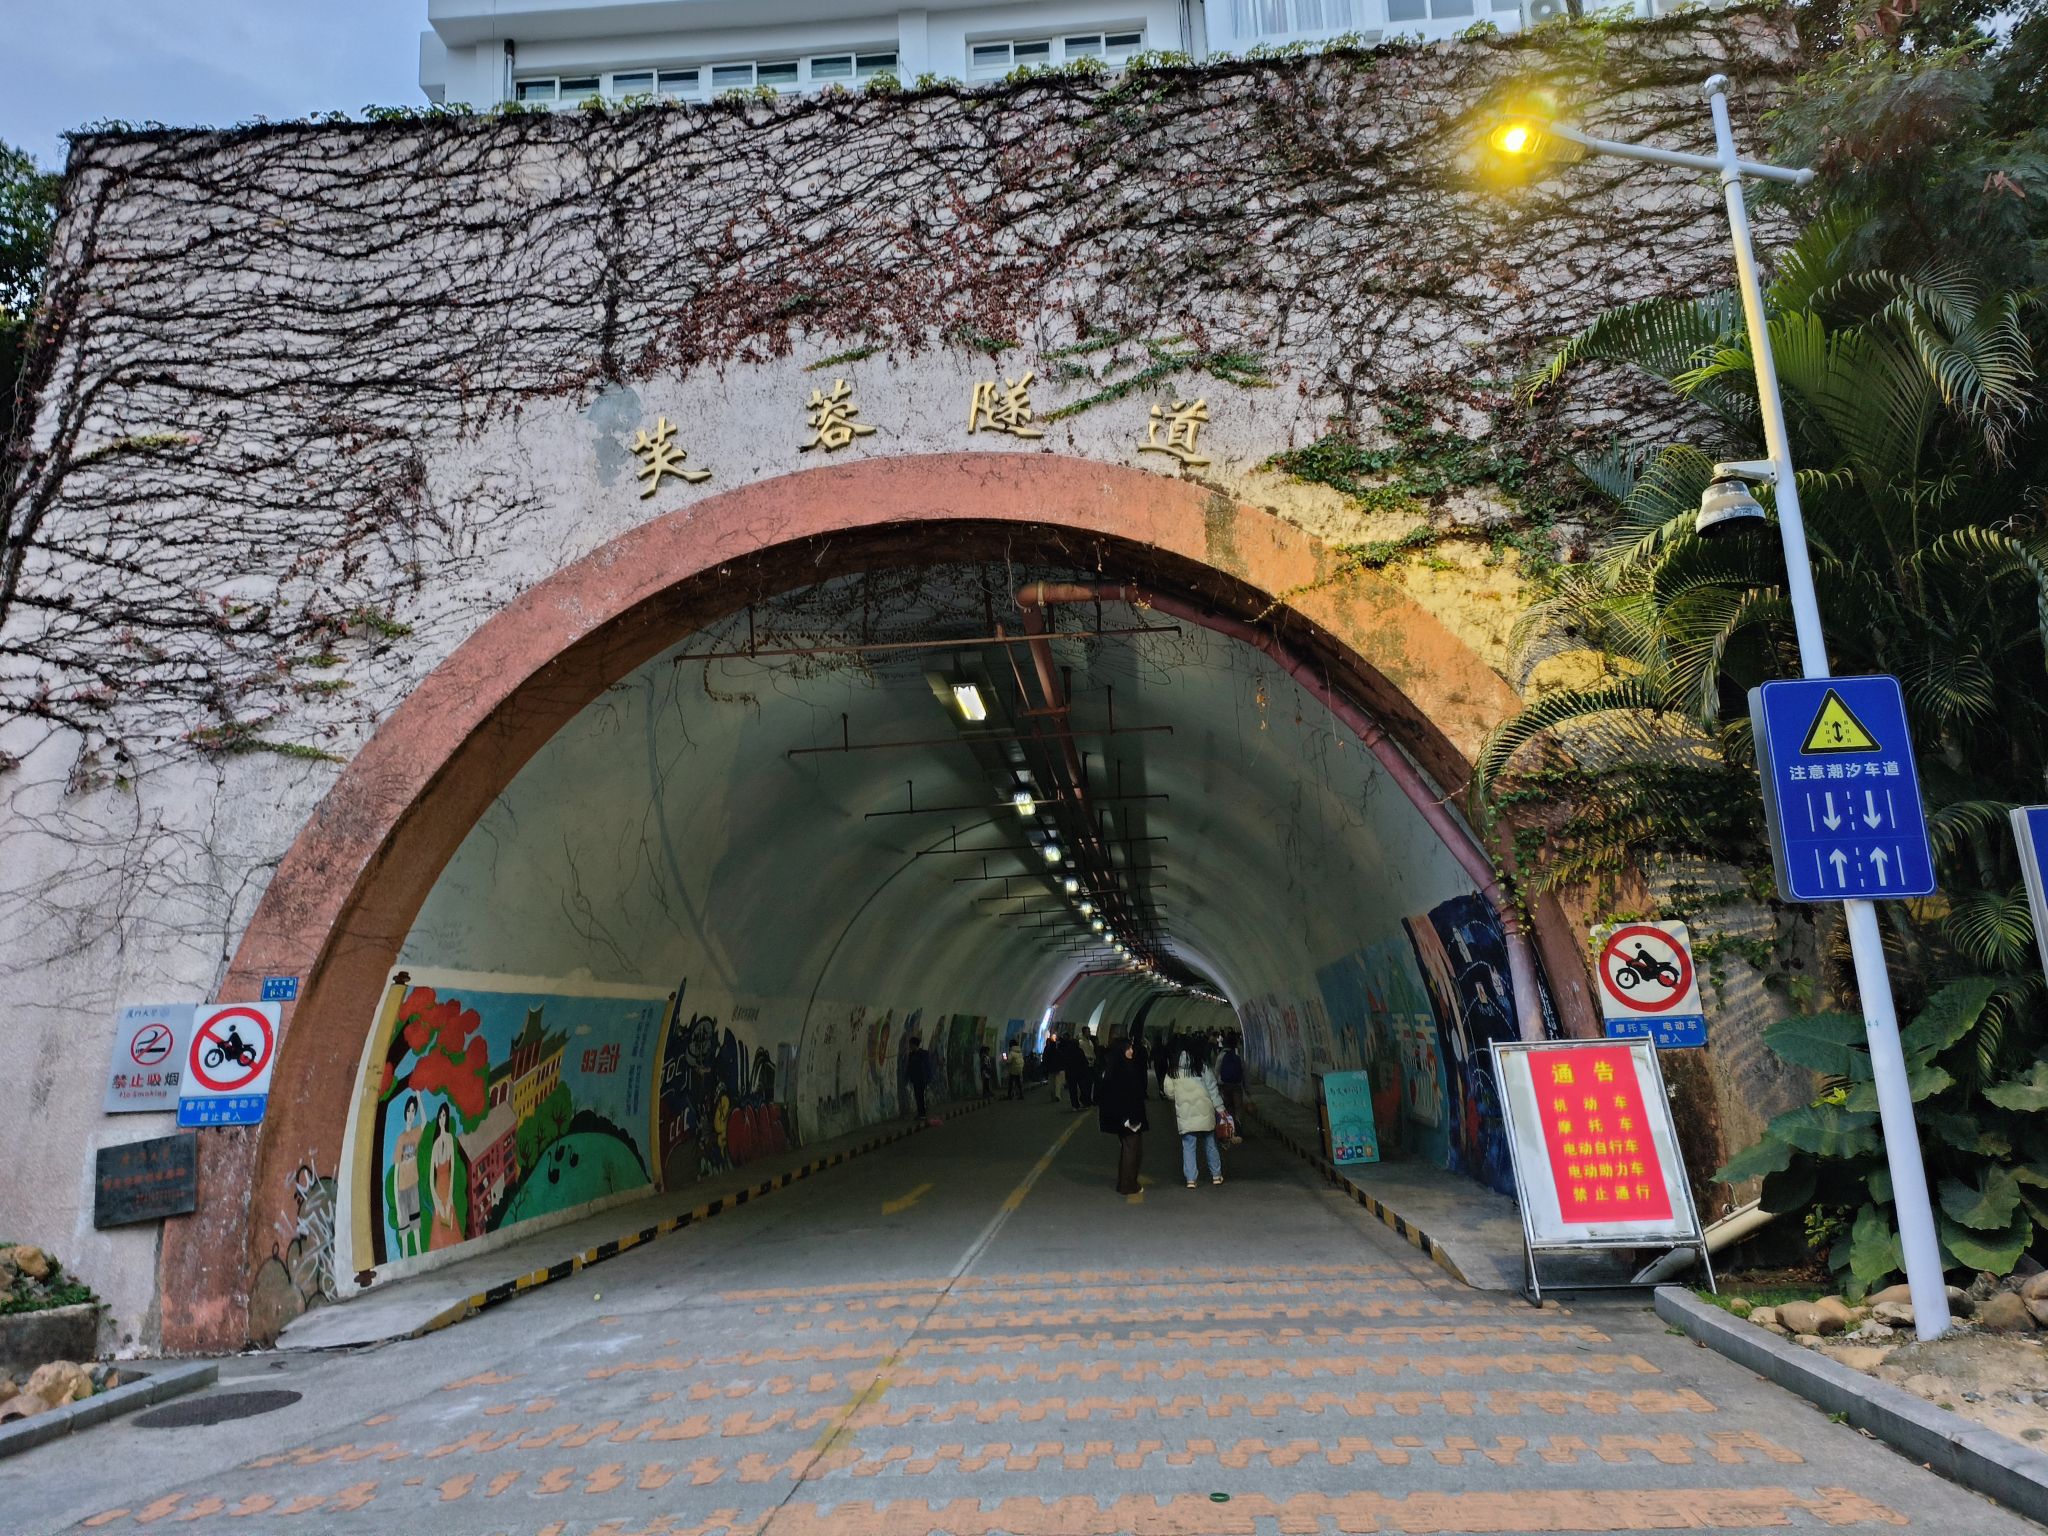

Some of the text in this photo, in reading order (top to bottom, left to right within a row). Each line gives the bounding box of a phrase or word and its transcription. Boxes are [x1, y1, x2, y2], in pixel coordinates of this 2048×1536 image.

[630, 371, 1212, 500] 芙蓉隧道
[1789, 761, 1900, 781] 注意潮汐车道
[1616, 1021, 1697, 1033] 摩托车 电动车
[112, 1072, 180, 1089] 禁止吸烟
[1552, 1061, 1614, 1084] 通告
[186, 1099, 259, 1111] 摩托车 电动车
[1554, 1096, 1627, 1112] 机动车
[1558, 1117, 1632, 1133] 摩托车
[1563, 1140, 1638, 1156] 电动自行车
[1568, 1161, 1645, 1178] 电动助力车
[1573, 1184, 1650, 1202] 禁止通行
